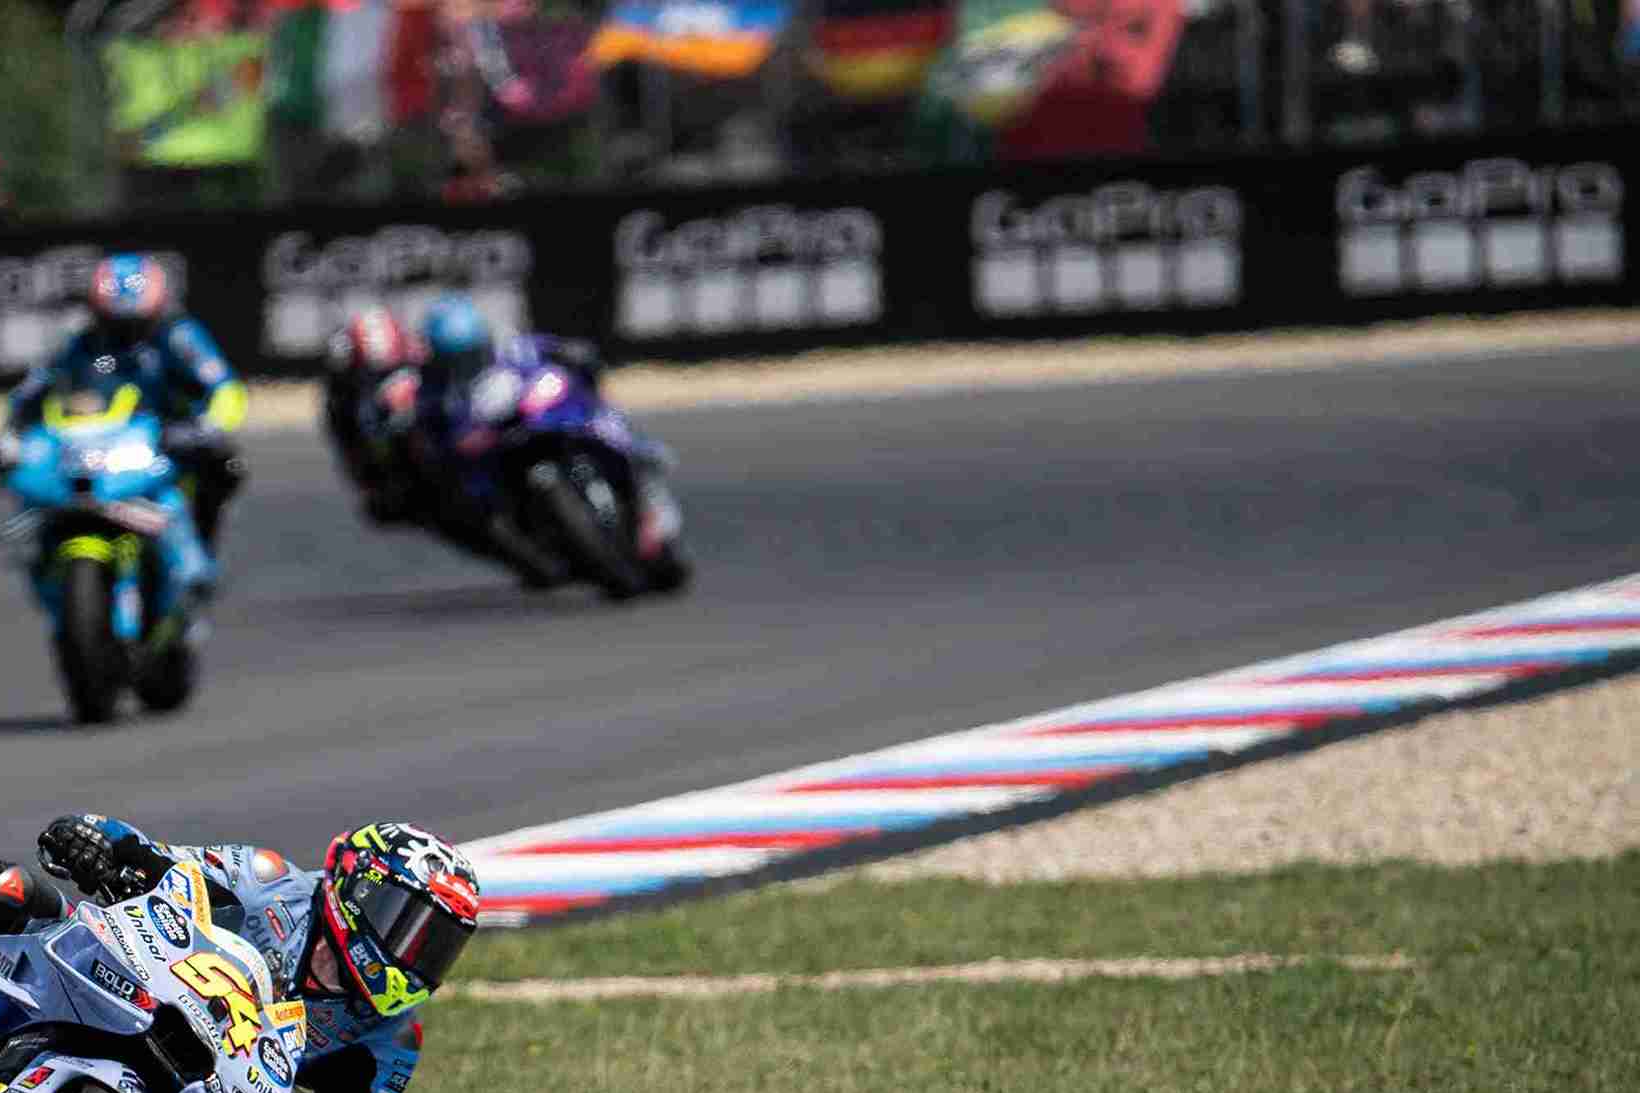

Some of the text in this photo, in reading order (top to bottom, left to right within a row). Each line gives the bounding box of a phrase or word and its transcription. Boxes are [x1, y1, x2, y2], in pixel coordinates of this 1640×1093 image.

[123, 905, 167, 962] Unibat
[93, 961, 136, 996] BOLD
[169, 950, 264, 1059] 54
